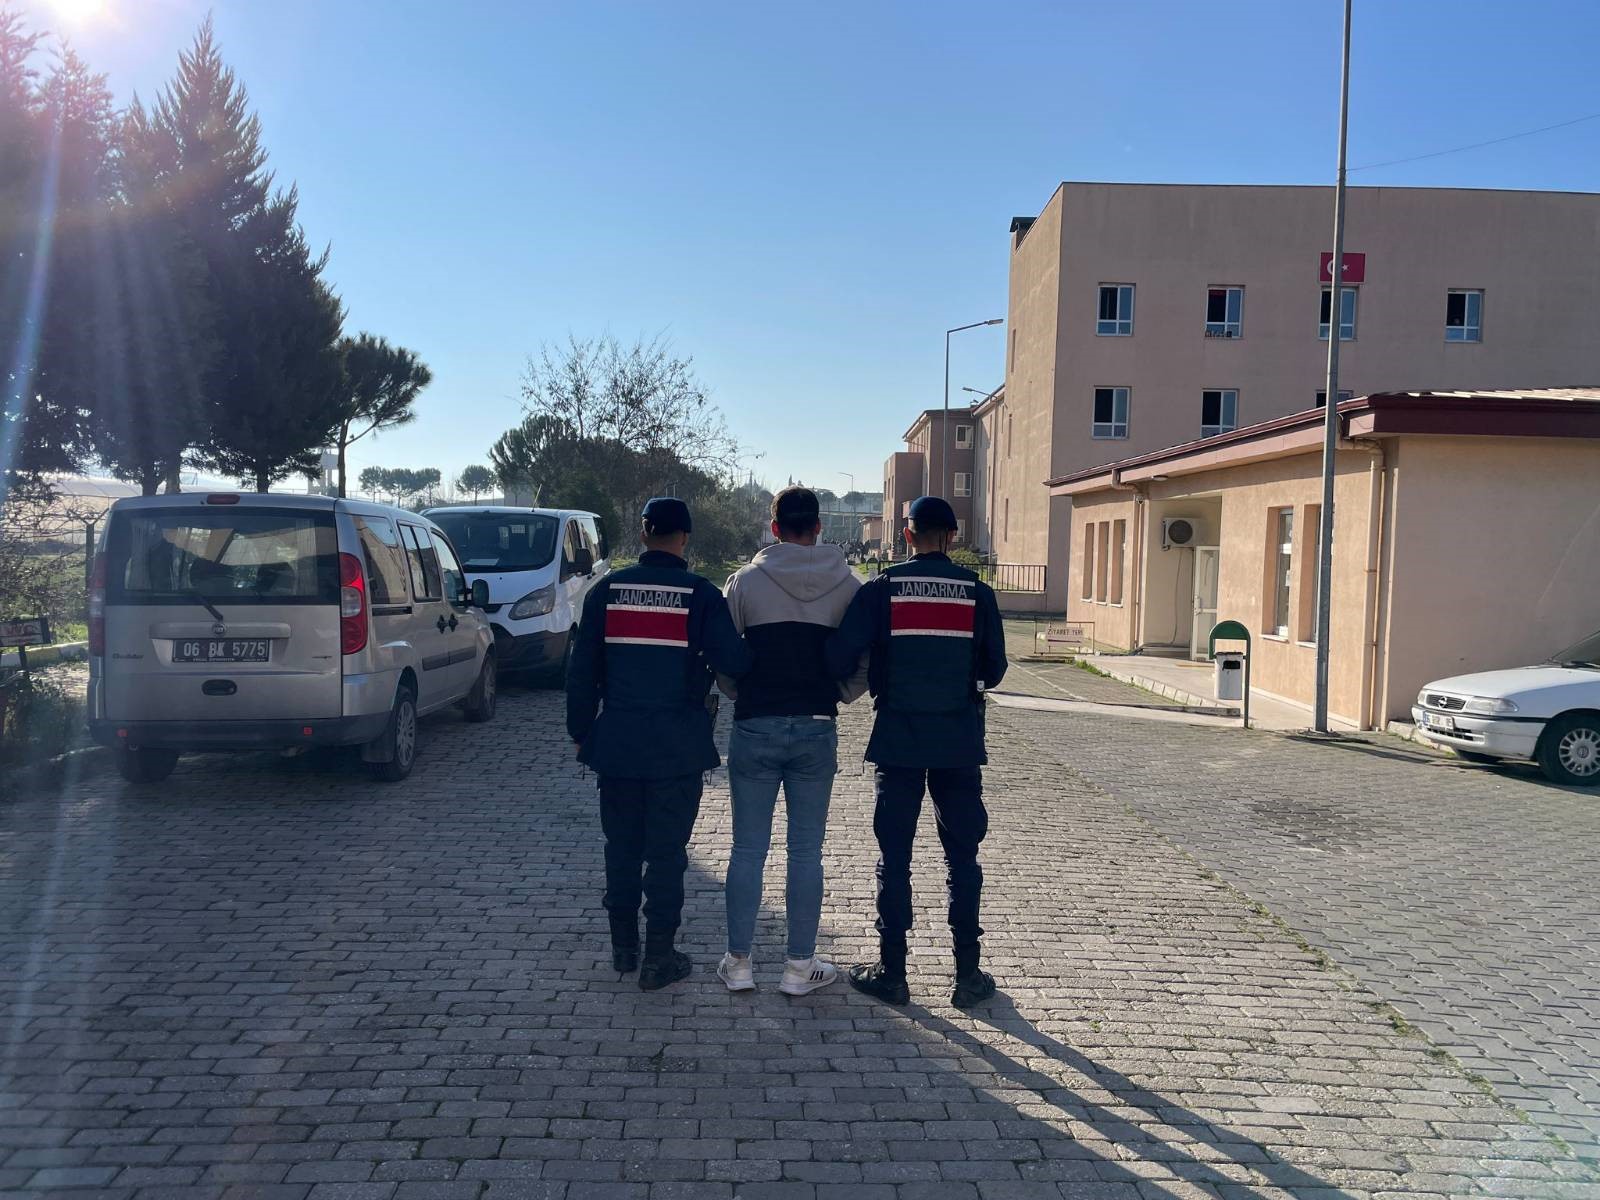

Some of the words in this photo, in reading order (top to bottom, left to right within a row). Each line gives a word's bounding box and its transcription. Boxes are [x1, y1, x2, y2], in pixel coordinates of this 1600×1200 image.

[898, 581, 967, 599] JANDARMA
[615, 591, 682, 608] JANDARMA
[183, 642, 200, 657] 06
[208, 642, 225, 657] BK
[232, 642, 265, 657] 5775
